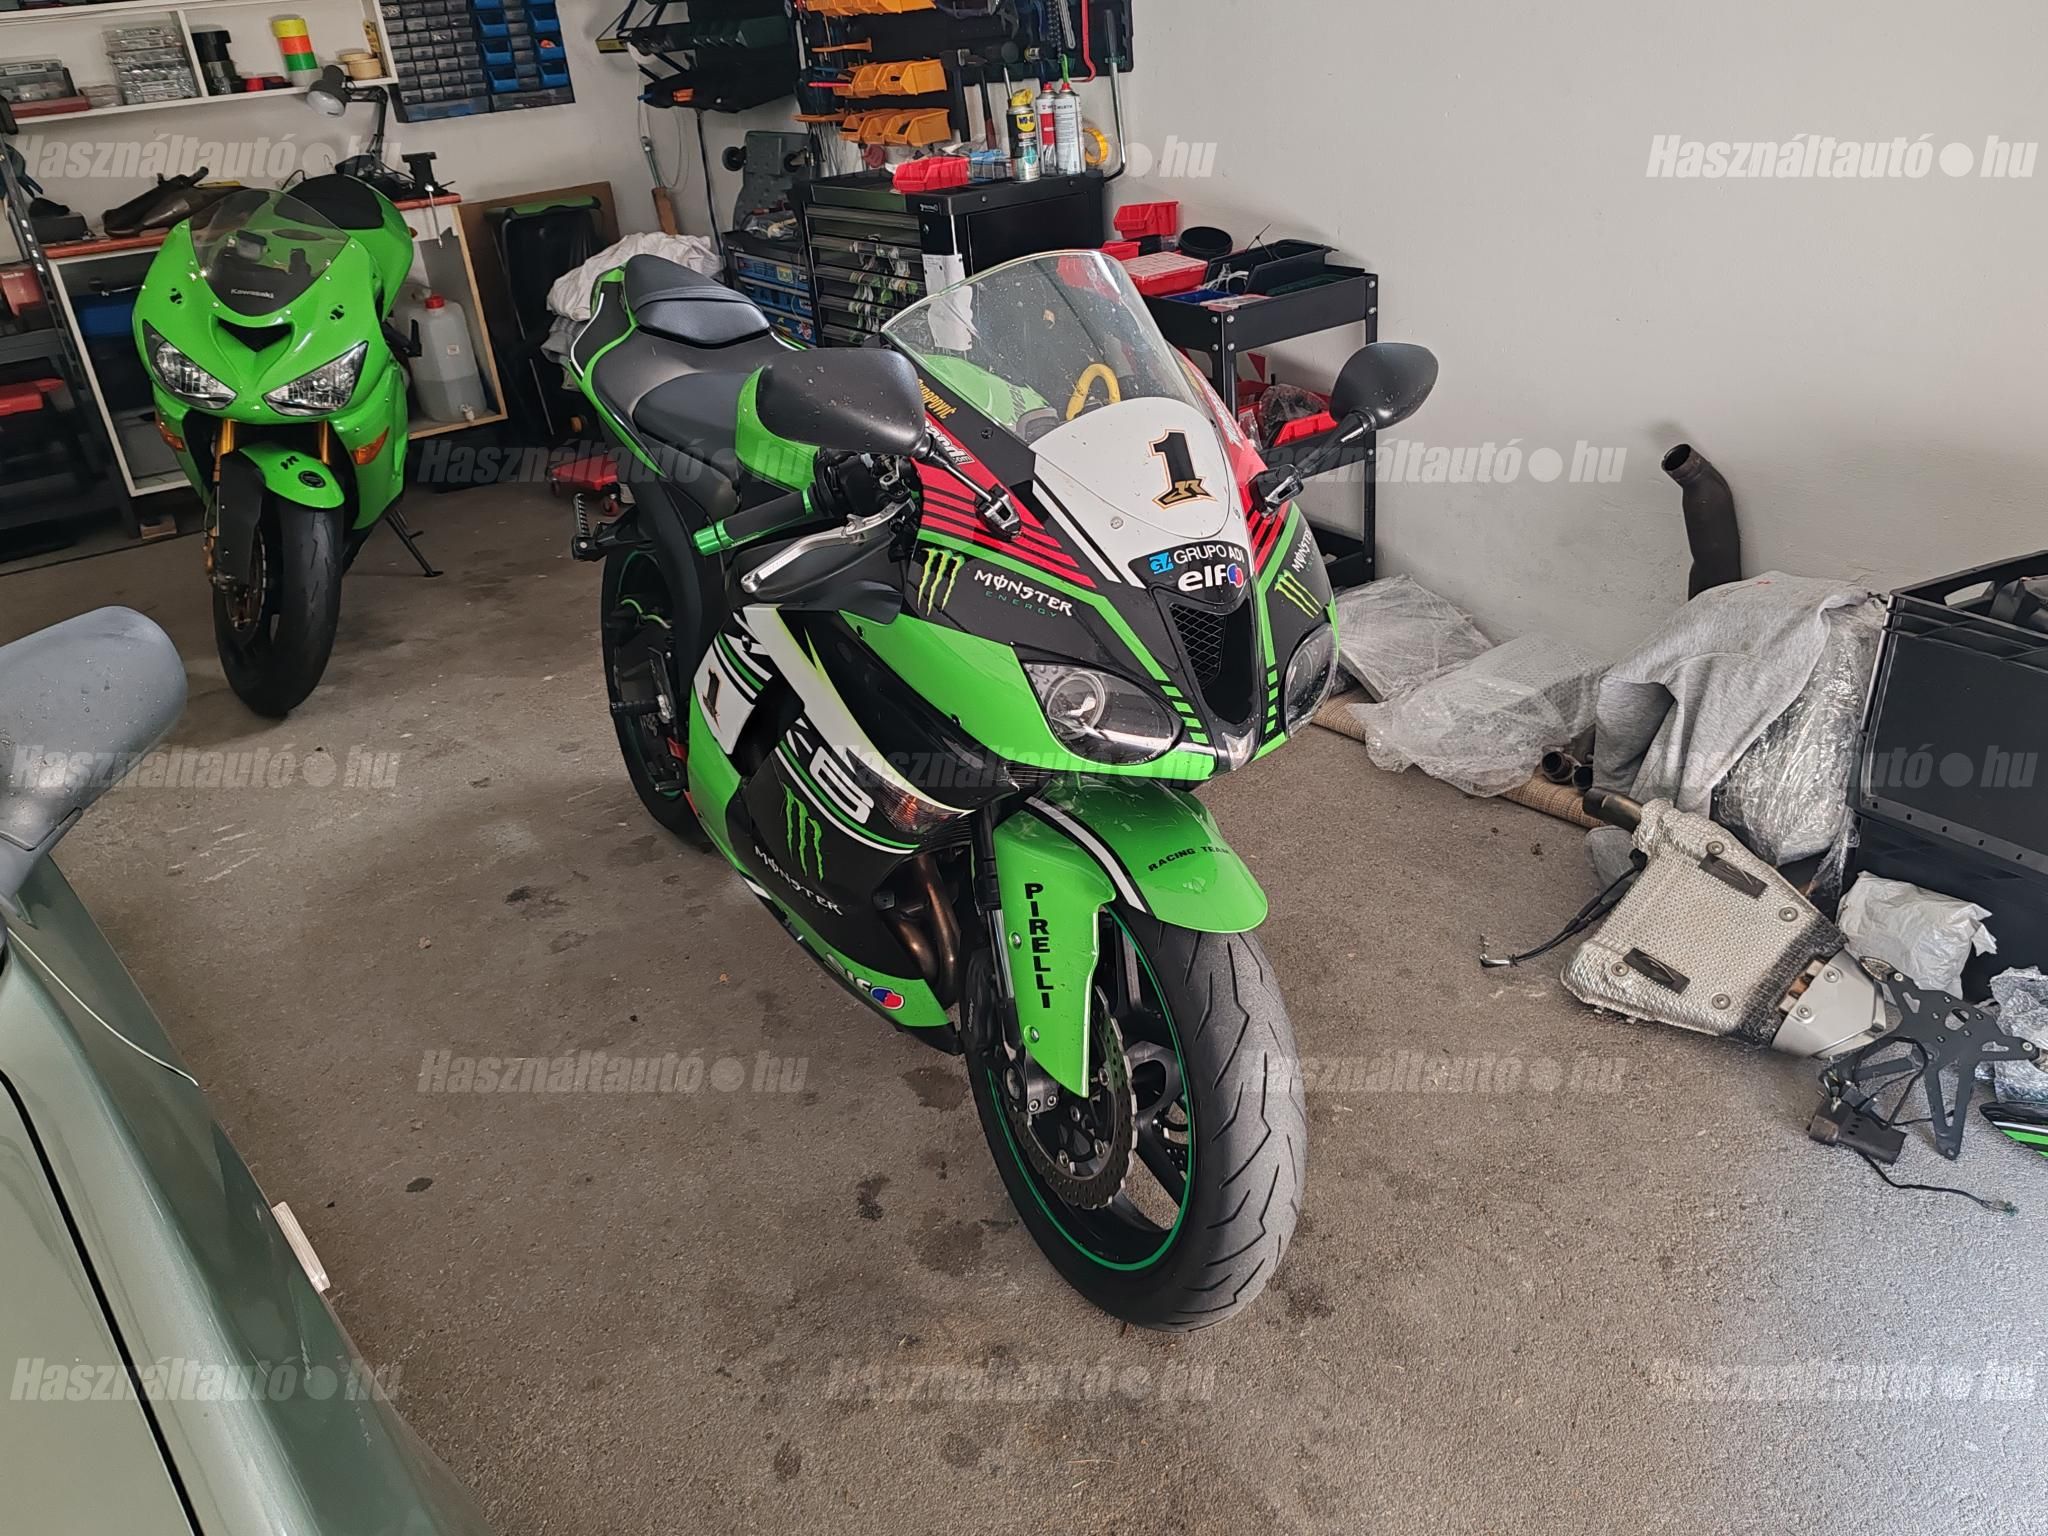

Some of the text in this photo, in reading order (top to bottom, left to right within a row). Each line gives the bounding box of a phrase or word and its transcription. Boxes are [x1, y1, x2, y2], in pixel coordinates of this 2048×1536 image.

[1173, 544, 1226, 564] GRUPO
[1178, 564, 1227, 592] elf
[974, 569, 1073, 617] MONSTER
[1147, 847, 1197, 873] RACING
[1024, 882, 1055, 1010] PIRELLI
